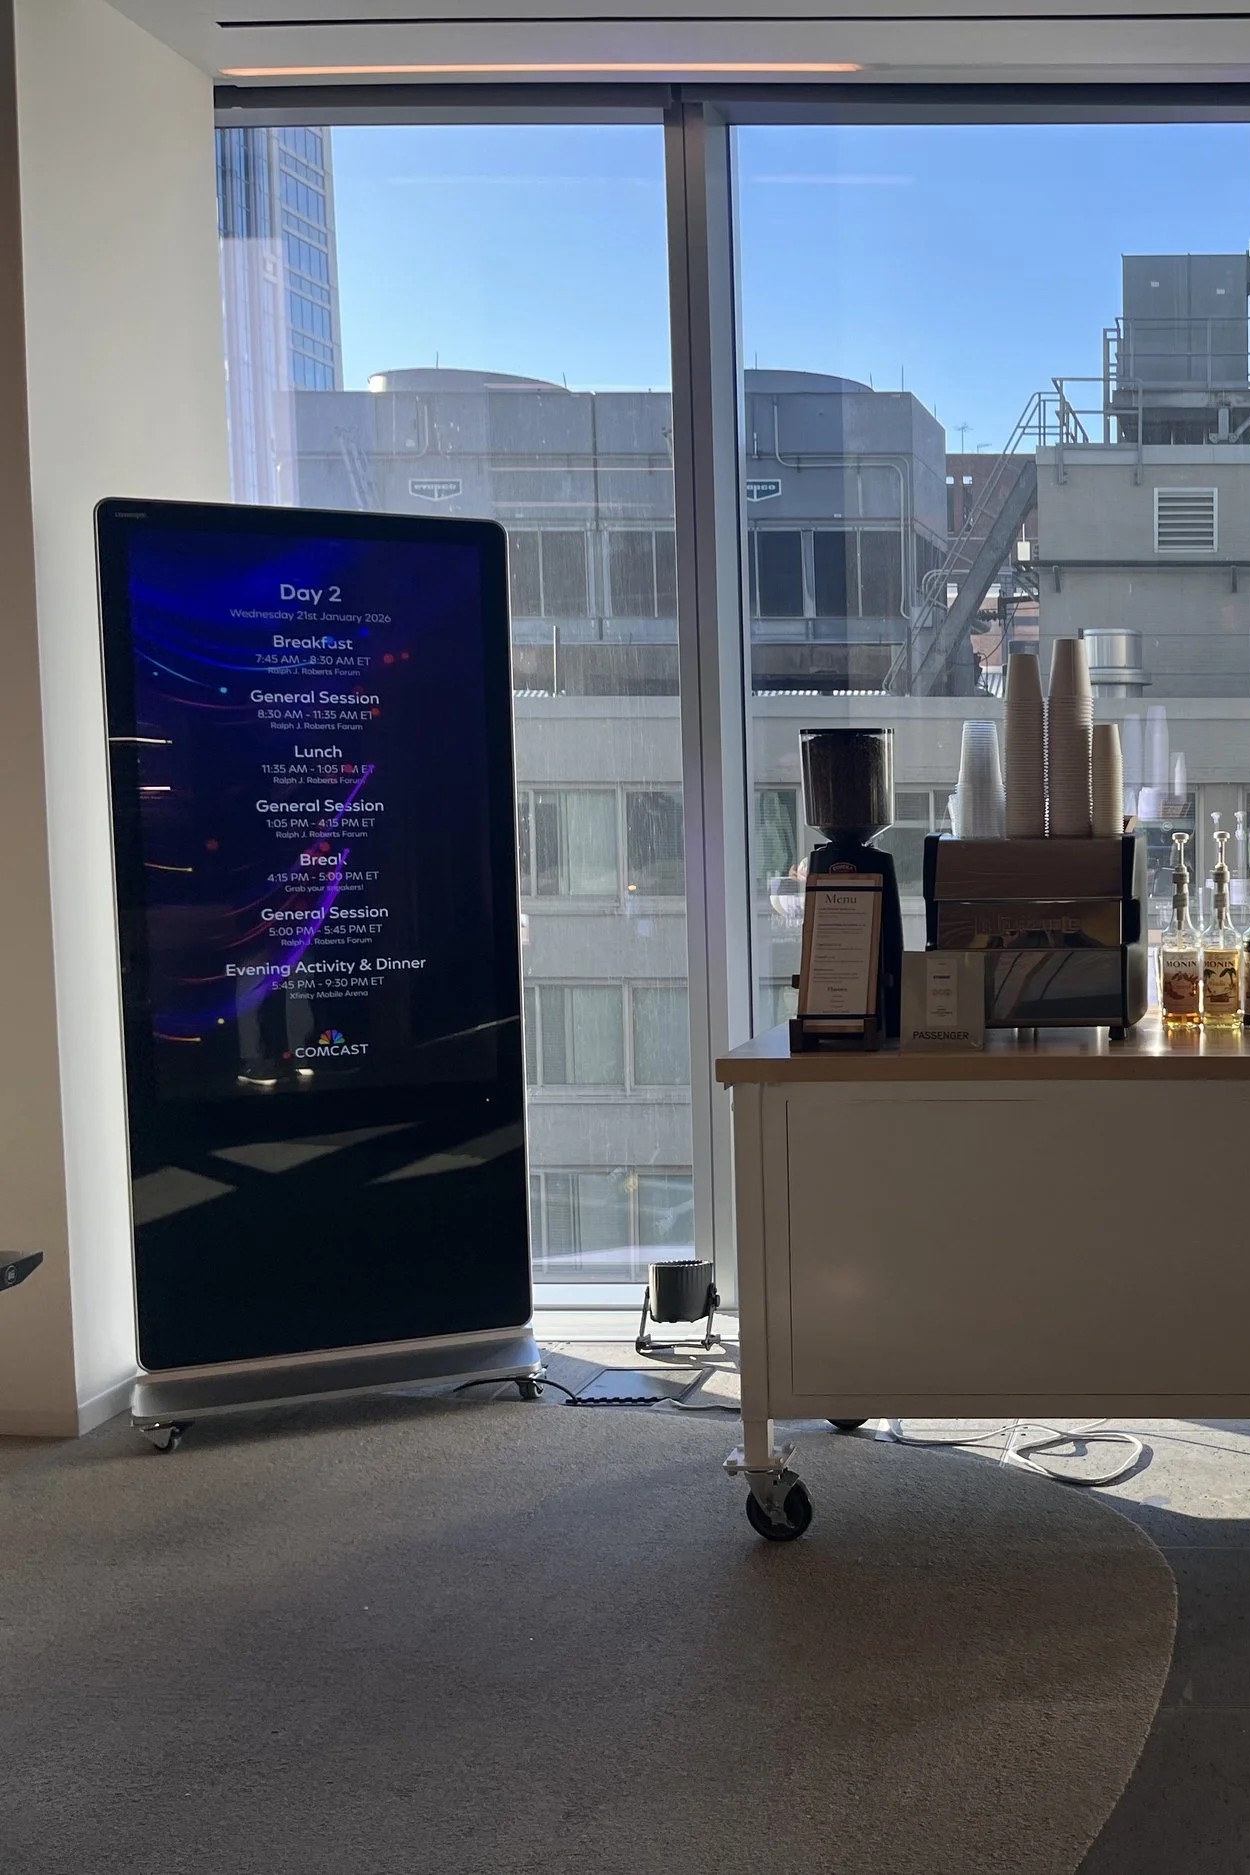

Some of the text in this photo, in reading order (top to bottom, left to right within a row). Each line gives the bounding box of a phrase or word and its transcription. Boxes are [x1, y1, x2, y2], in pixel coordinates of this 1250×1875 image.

[280, 584, 342, 605] Day 2
[229, 608, 391, 624] Wednesday 21st January 2026
[273, 635, 353, 650] Breakfast
[256, 654, 278, 664] 7:45
[281, 655, 299, 664] AM
[309, 655, 333, 665] 8:30
[336, 656, 354, 666] AM
[357, 656, 371, 666] ET
[268, 667, 292, 676] Ralph
[302, 667, 333, 676] Roberts
[335, 668, 361, 676] Forum
[250, 689, 379, 704] General Session
[257, 709, 281, 719] 8:30
[284, 710, 303, 719] AM
[313, 710, 337, 719] 11:35
[339, 711, 358, 720] AM
[360, 711, 373, 720] ET
[270, 722, 294, 730] Ralph
[304, 722, 335, 730] Roberts
[294, 745, 343, 758] Lunch
[262, 764, 286, 773] 11:35
[288, 764, 308, 773] AM
[317, 764, 338, 774] 1:05
[341, 764, 359, 774] PM
[361, 764, 374, 774] ET
[273, 777, 297, 785] Ralph
[256, 799, 384, 812] General Session
[266, 819, 287, 828] 1:05
[290, 819, 309, 828] PM
[318, 818, 339, 827] 4:15
[341, 818, 359, 827] PM
[362, 818, 375, 827] ET
[276, 831, 299, 839] Ralph
[342, 830, 368, 838] Forum
[300, 853, 347, 866] Break
[267, 873, 288, 882] 4:15
[290, 873, 309, 882] PM
[319, 872, 342, 881] 5:00
[345, 872, 363, 881] PM
[365, 871, 379, 880] ET
[285, 885, 306, 893] Grab
[826, 893, 857, 904] Menu
[261, 906, 389, 921] General Session
[269, 927, 293, 936] 5:00
[296, 926, 315, 935] PM
[324, 925, 346, 935] 5:45
[349, 925, 366, 934] PM
[369, 924, 383, 933] ET
[281, 939, 304, 947] Ralph
[314, 937, 345, 945] Roberts
[225, 957, 426, 978] Evening Activity & Dinner
[272, 981, 294, 991] 5:45
[297, 980, 316, 989] PM
[325, 978, 348, 988] 9:30
[351, 978, 369, 987] PM
[370, 977, 385, 986] ET
[290, 992, 315, 1000] Xfinity
[316, 991, 343, 999] Mobile
[913, 1031, 969, 1040] PASSENGER
[295, 1044, 369, 1059] COMCAST
